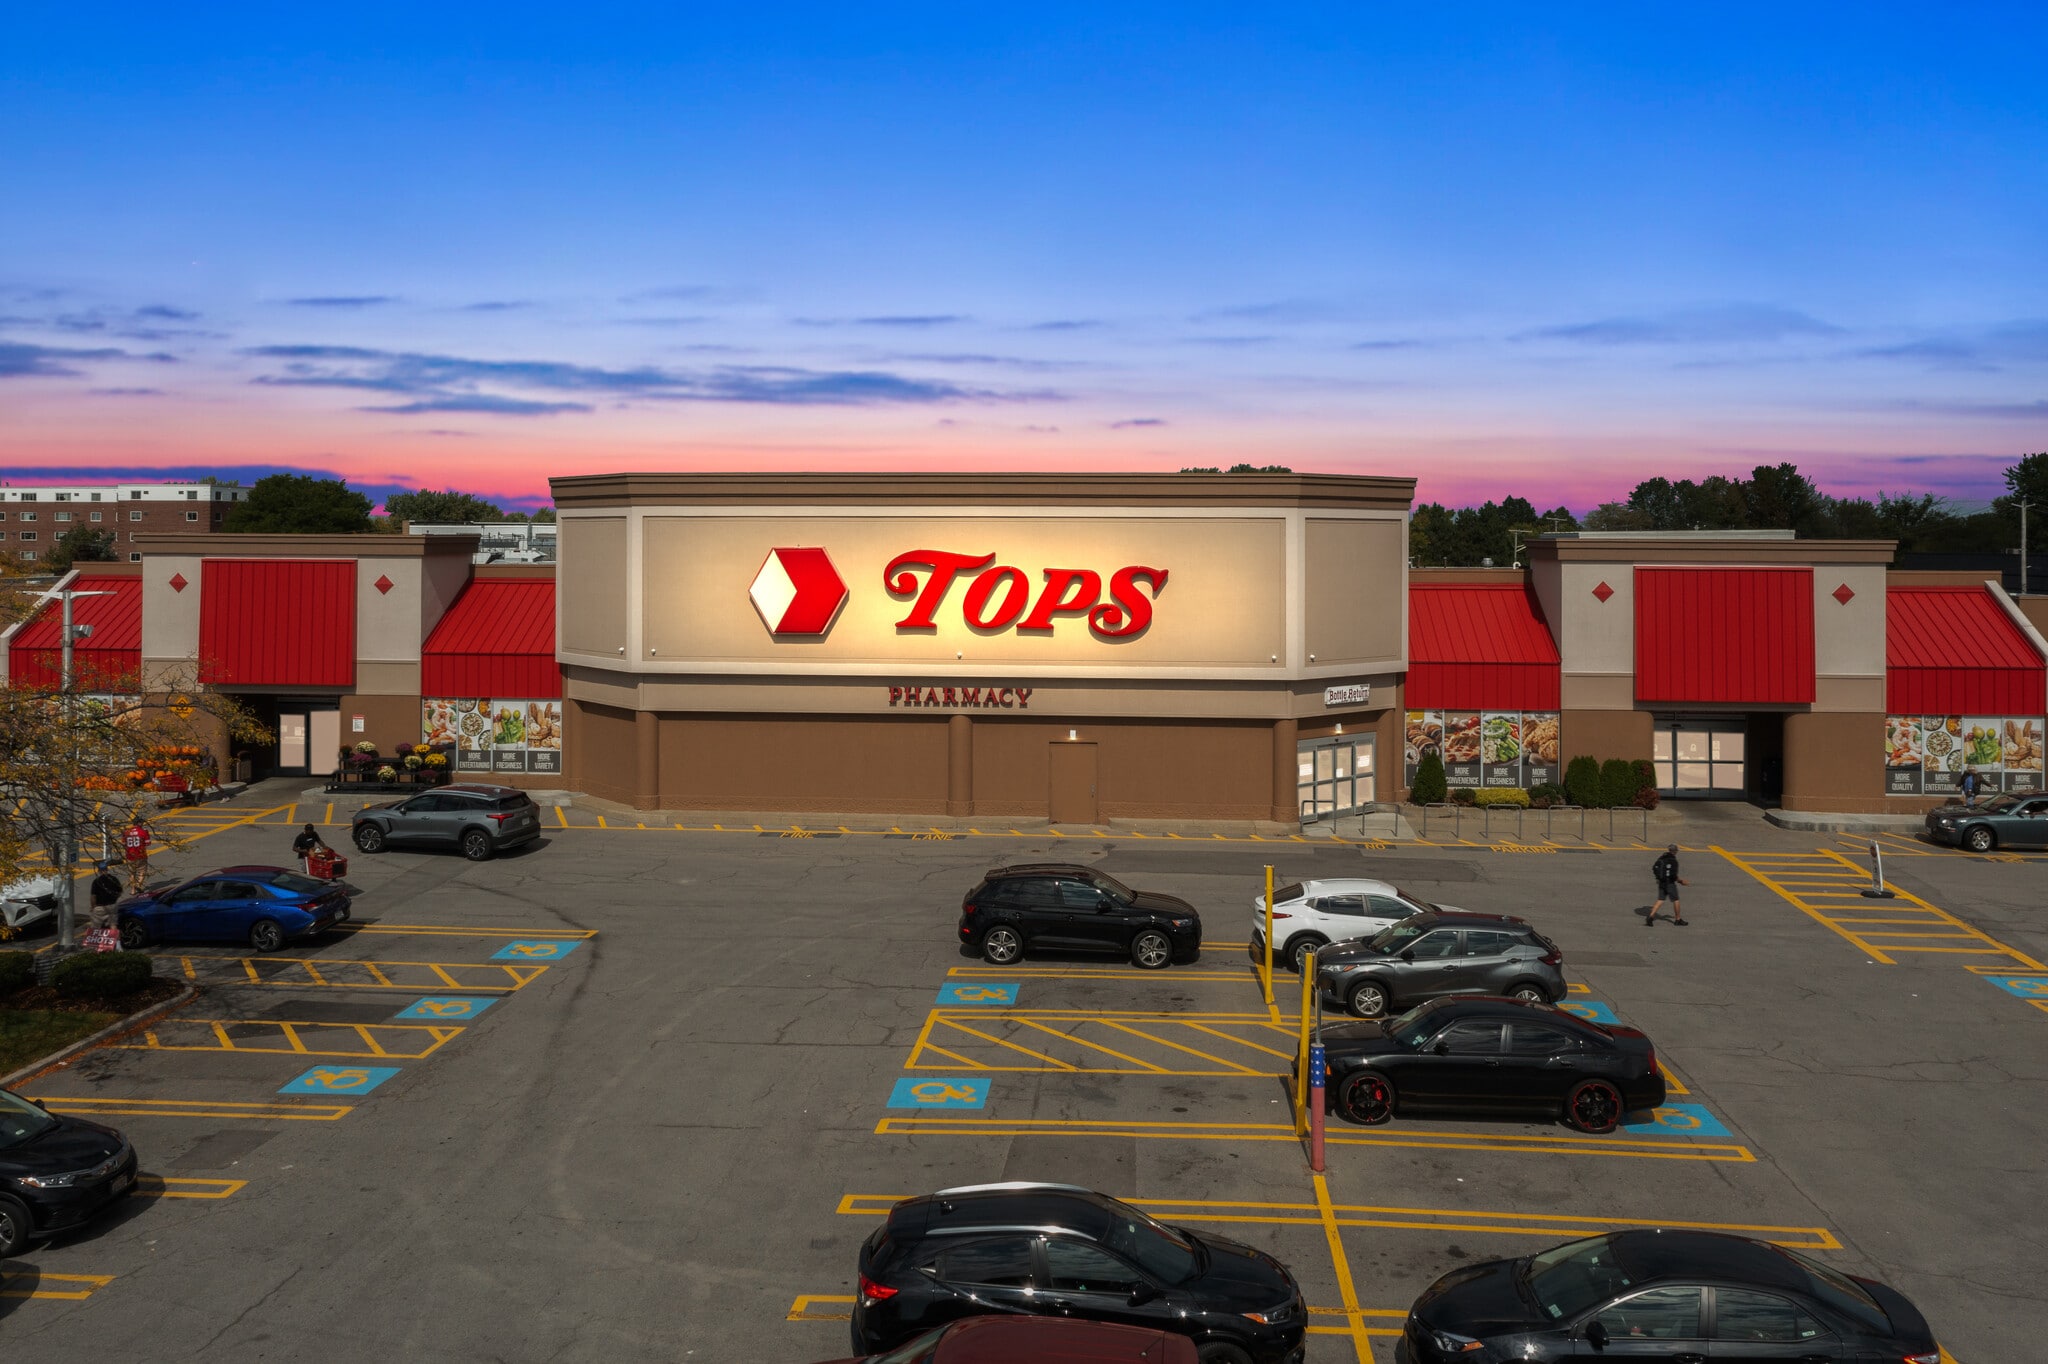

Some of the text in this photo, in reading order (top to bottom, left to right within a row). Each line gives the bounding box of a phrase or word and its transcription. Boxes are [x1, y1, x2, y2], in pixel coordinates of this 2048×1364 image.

[888, 686, 1032, 706] PHARMACY
[1329, 687, 1368, 701] Bottle Return
[468, 752, 481, 760] MORE
[502, 752, 516, 760] MORE
[1454, 767, 1470, 775] MORE
[2015, 774, 2031, 783] MORE
[1892, 783, 1914, 791] QUALITY
[779, 831, 954, 842] FIRE LANE
[1364, 842, 1557, 854] NO PARKING
[92, 929, 110, 937] FLU
[85, 936, 115, 945] SHOTS
